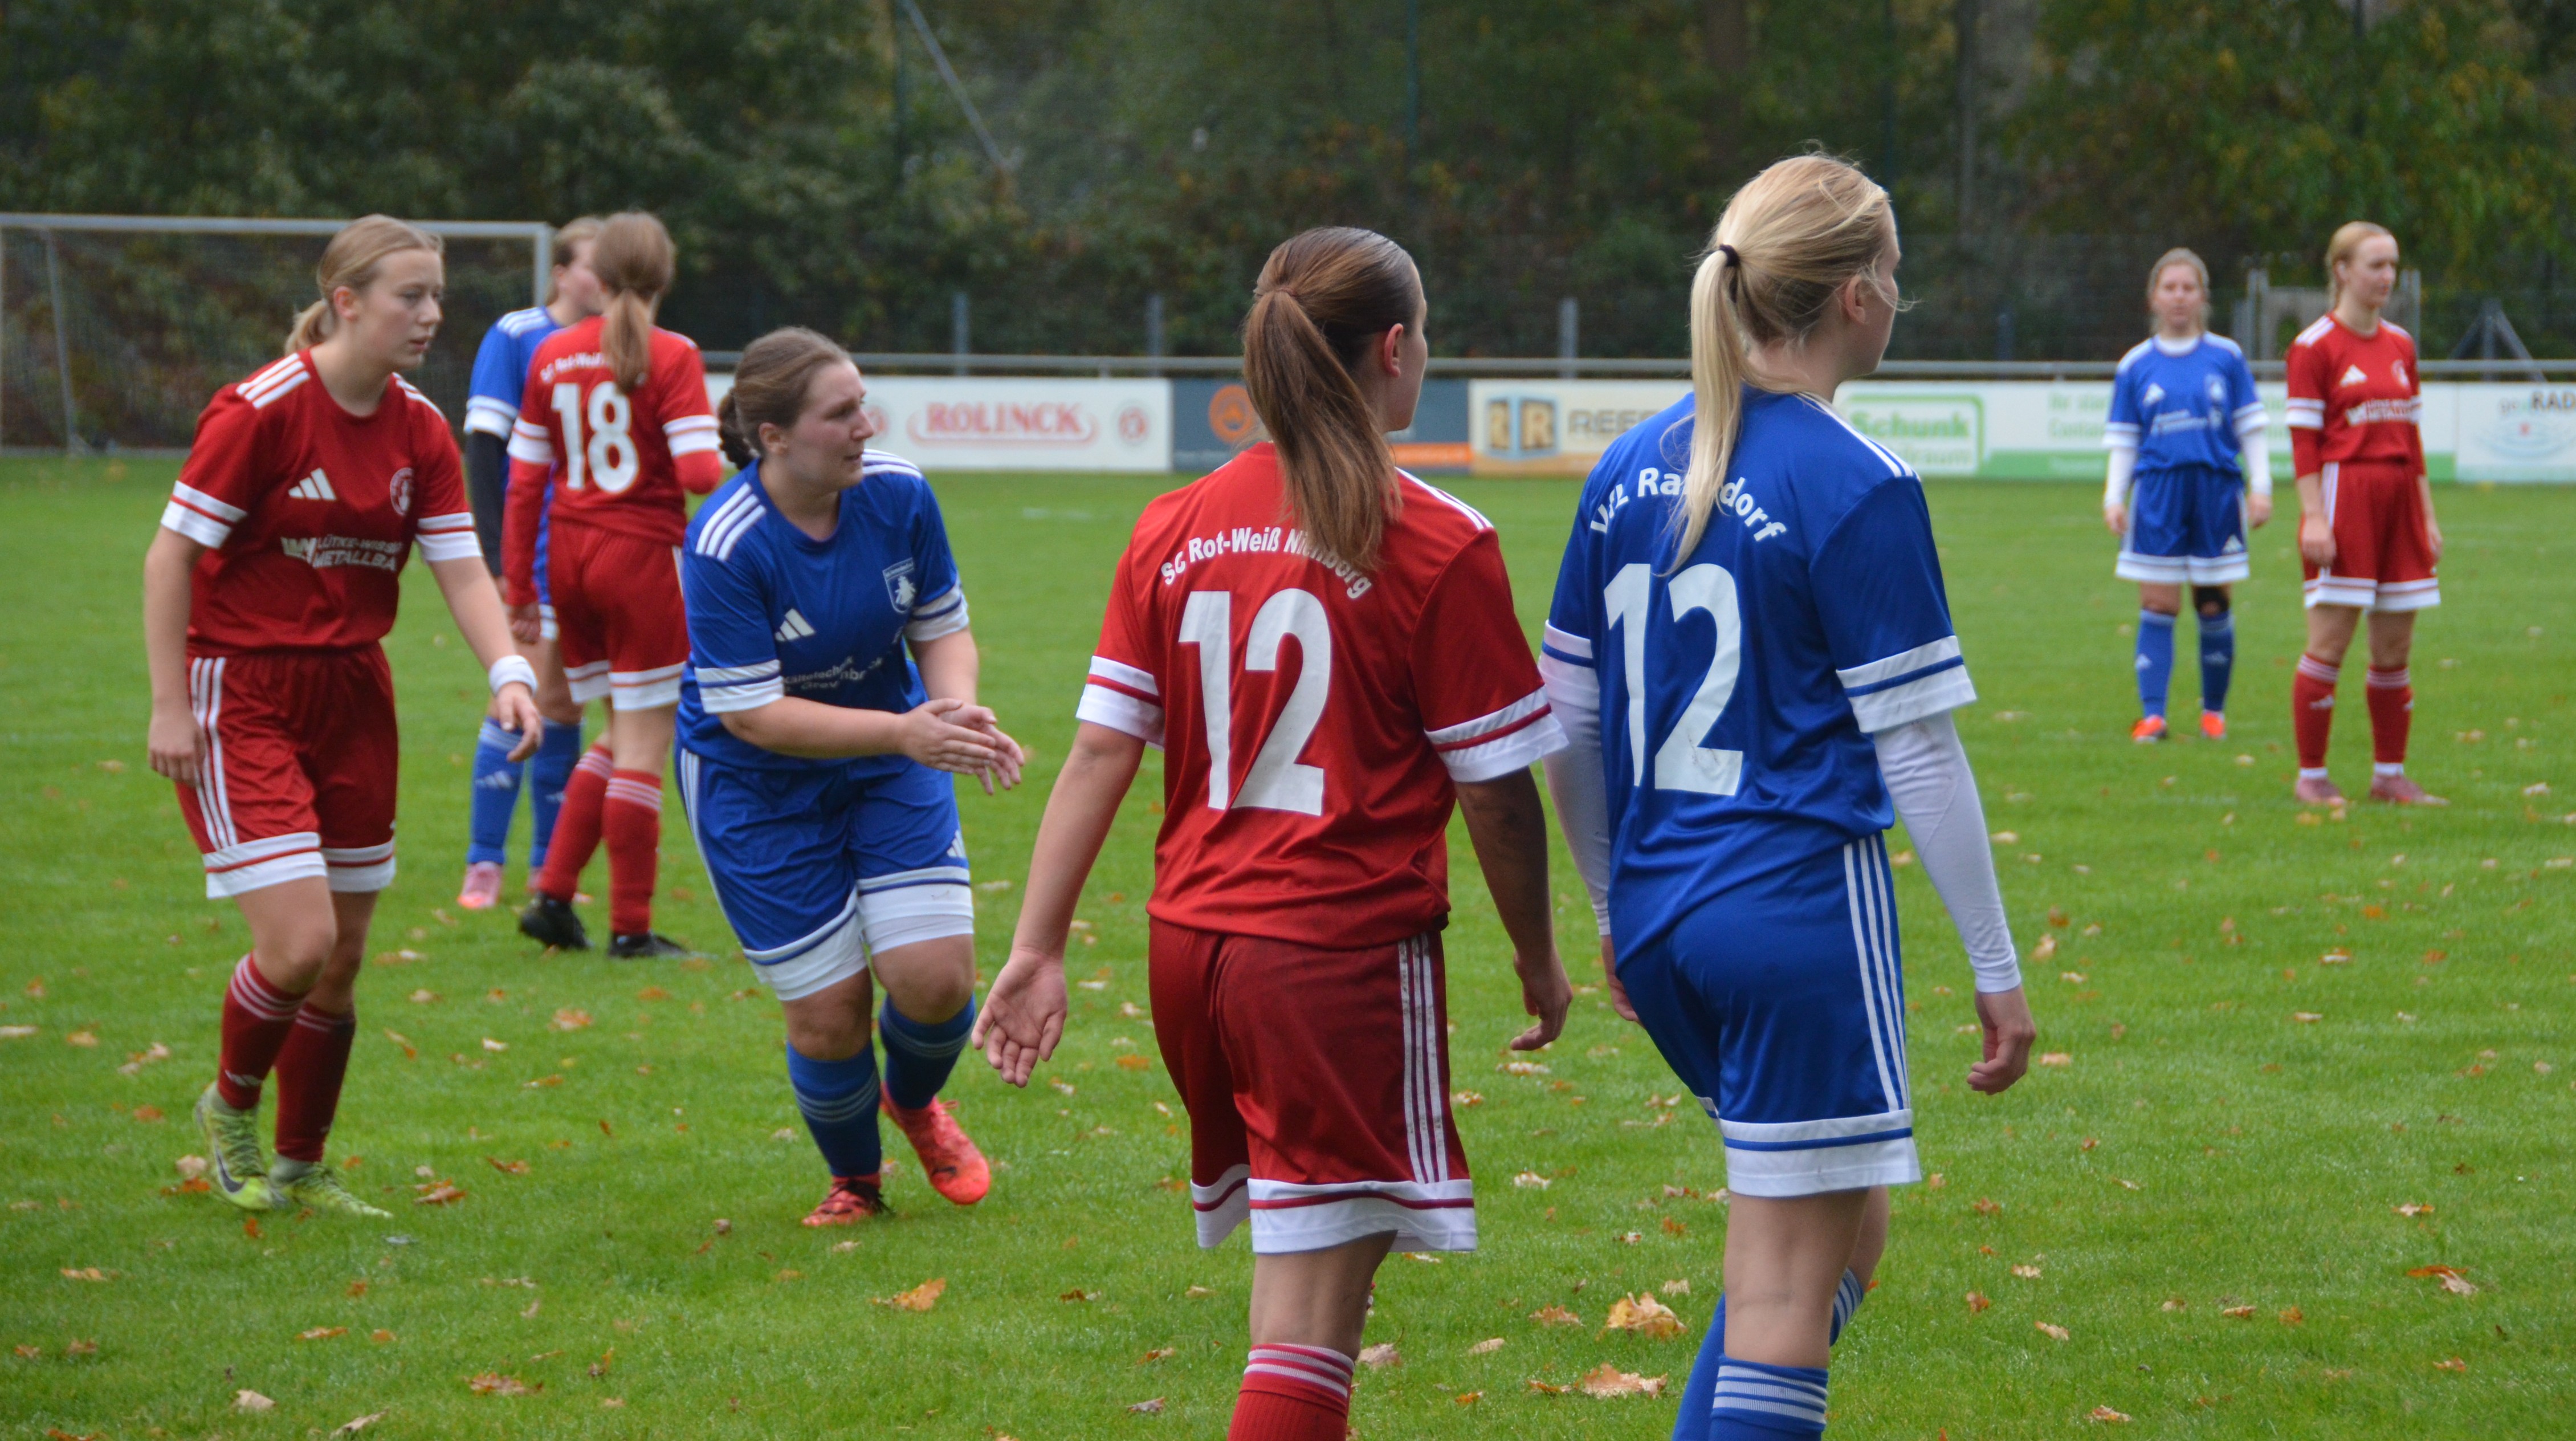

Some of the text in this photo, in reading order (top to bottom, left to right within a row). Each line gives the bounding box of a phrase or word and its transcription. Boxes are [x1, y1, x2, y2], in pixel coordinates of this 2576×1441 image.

[551, 381, 640, 494] 18
[926, 402, 1082, 433] ROLINCK
[1851, 411, 1970, 438] Schunk
[1637, 467, 1787, 542] Radorf
[1160, 551, 1187, 585] SC
[1188, 526, 1282, 563] Rot-Weiß
[1178, 588, 1331, 816] 12
[1603, 562, 1744, 796] 12
